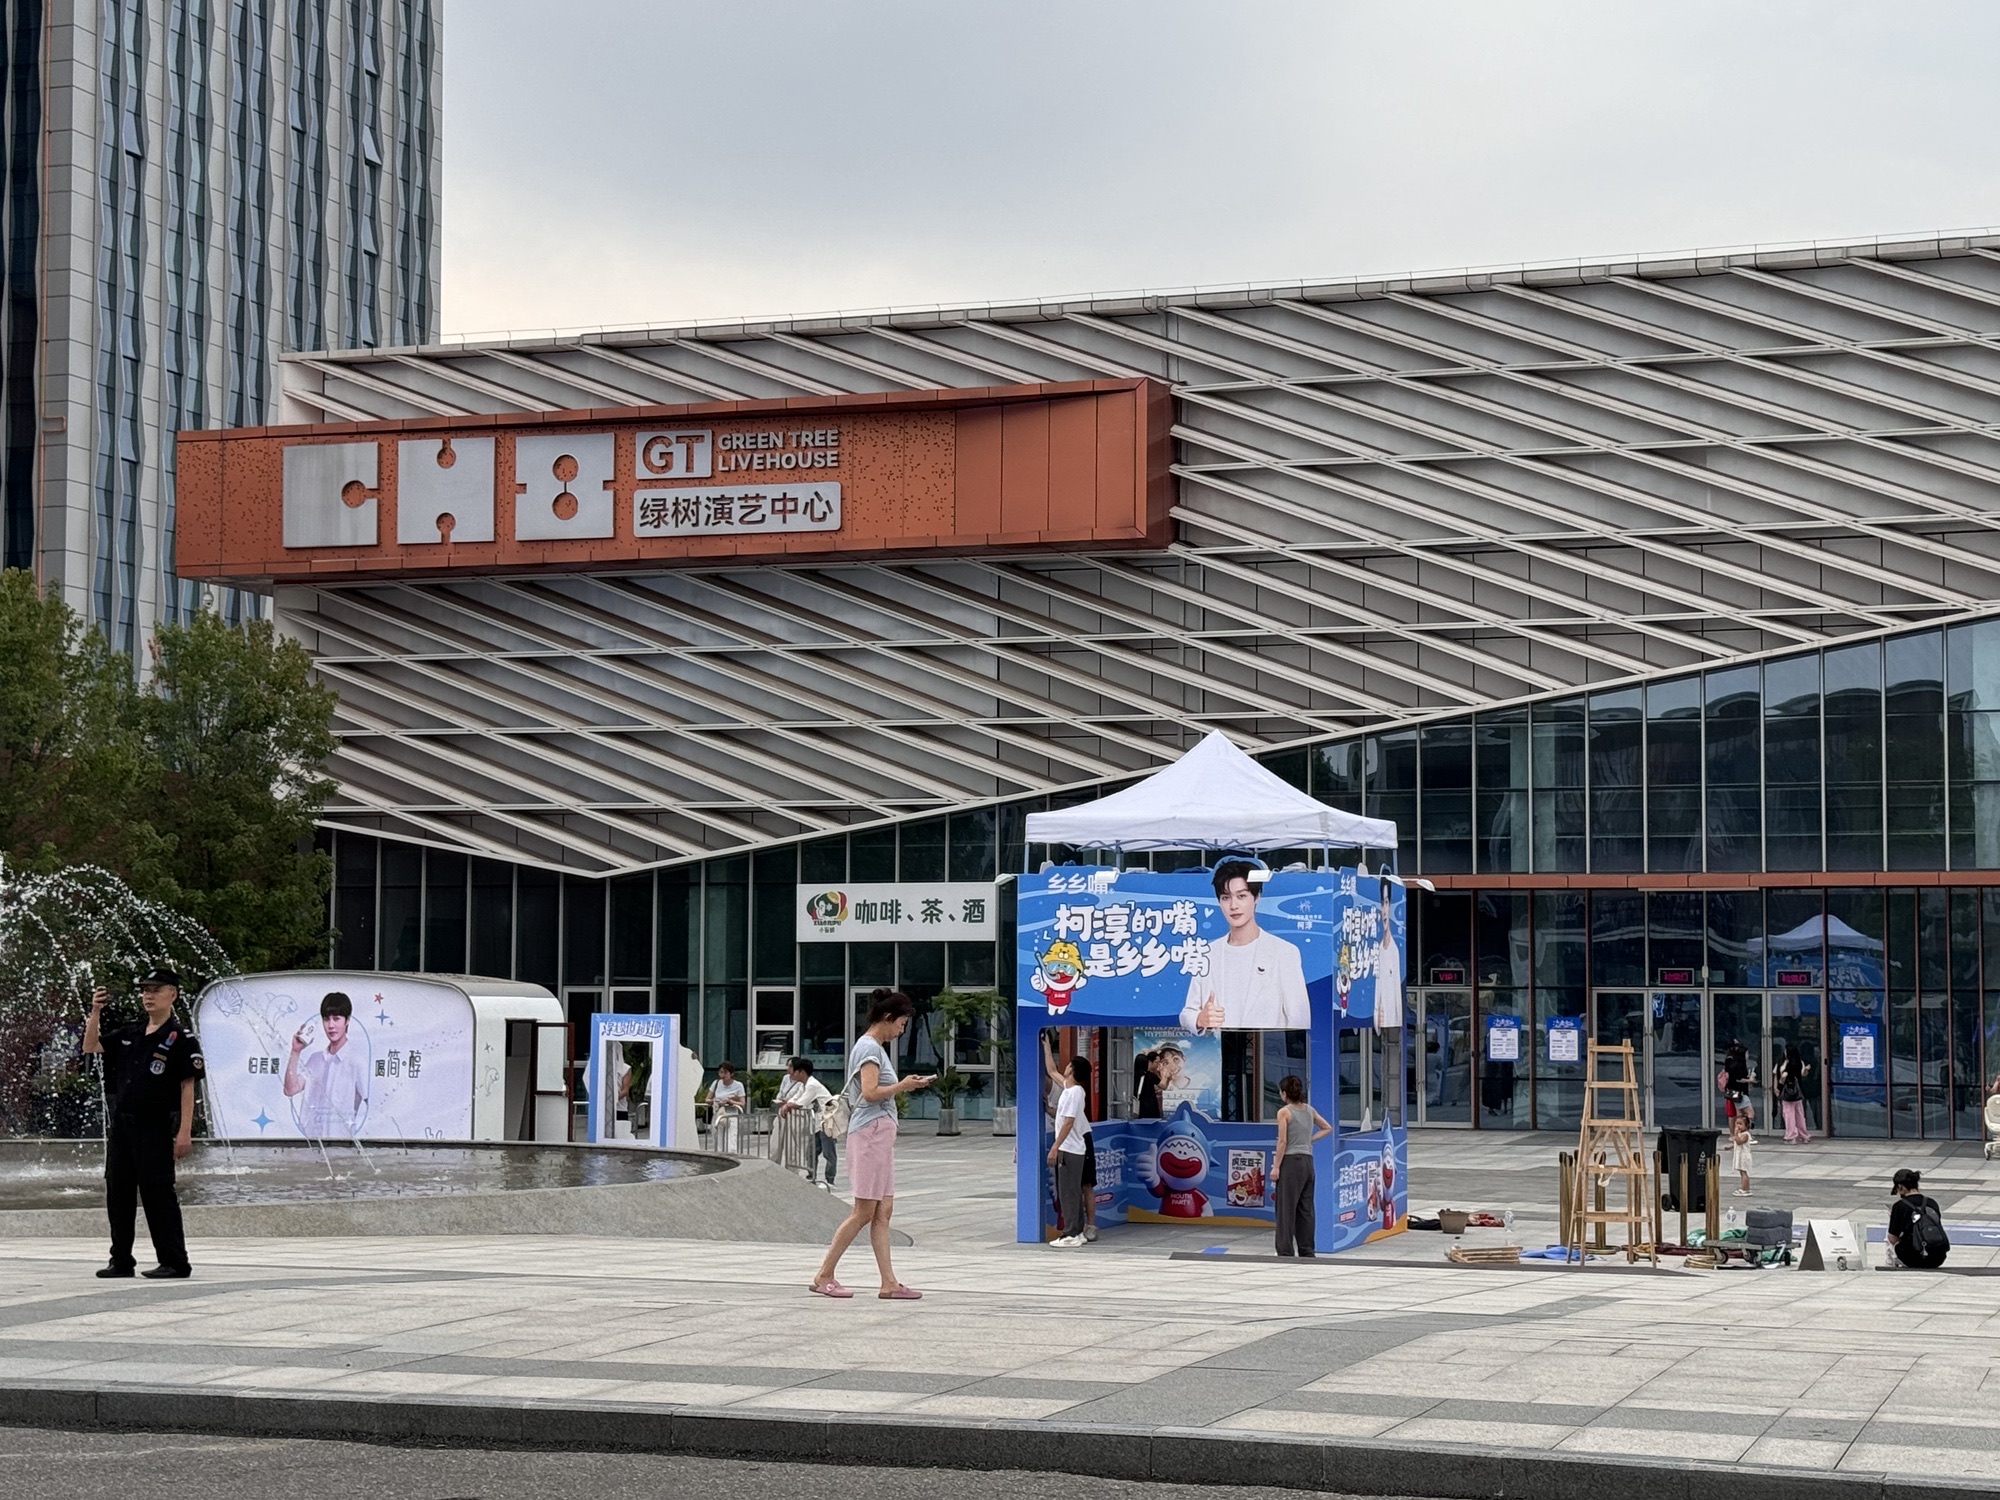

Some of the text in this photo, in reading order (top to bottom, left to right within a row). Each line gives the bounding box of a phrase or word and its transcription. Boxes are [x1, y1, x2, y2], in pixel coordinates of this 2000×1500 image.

[642, 434, 706, 475] GT
[717, 428, 840, 451] GREEN TREE
[717, 450, 840, 472] LIVEHOUSE
[638, 490, 834, 530] 绿树演艺中心
[854, 898, 986, 925] 咖啡、茶、酒
[1053, 900, 1198, 946] 柯淳的嘴
[1083, 936, 1212, 978] 是乡乡嘴
[1170, 1192, 1193, 1200] MOUTH
